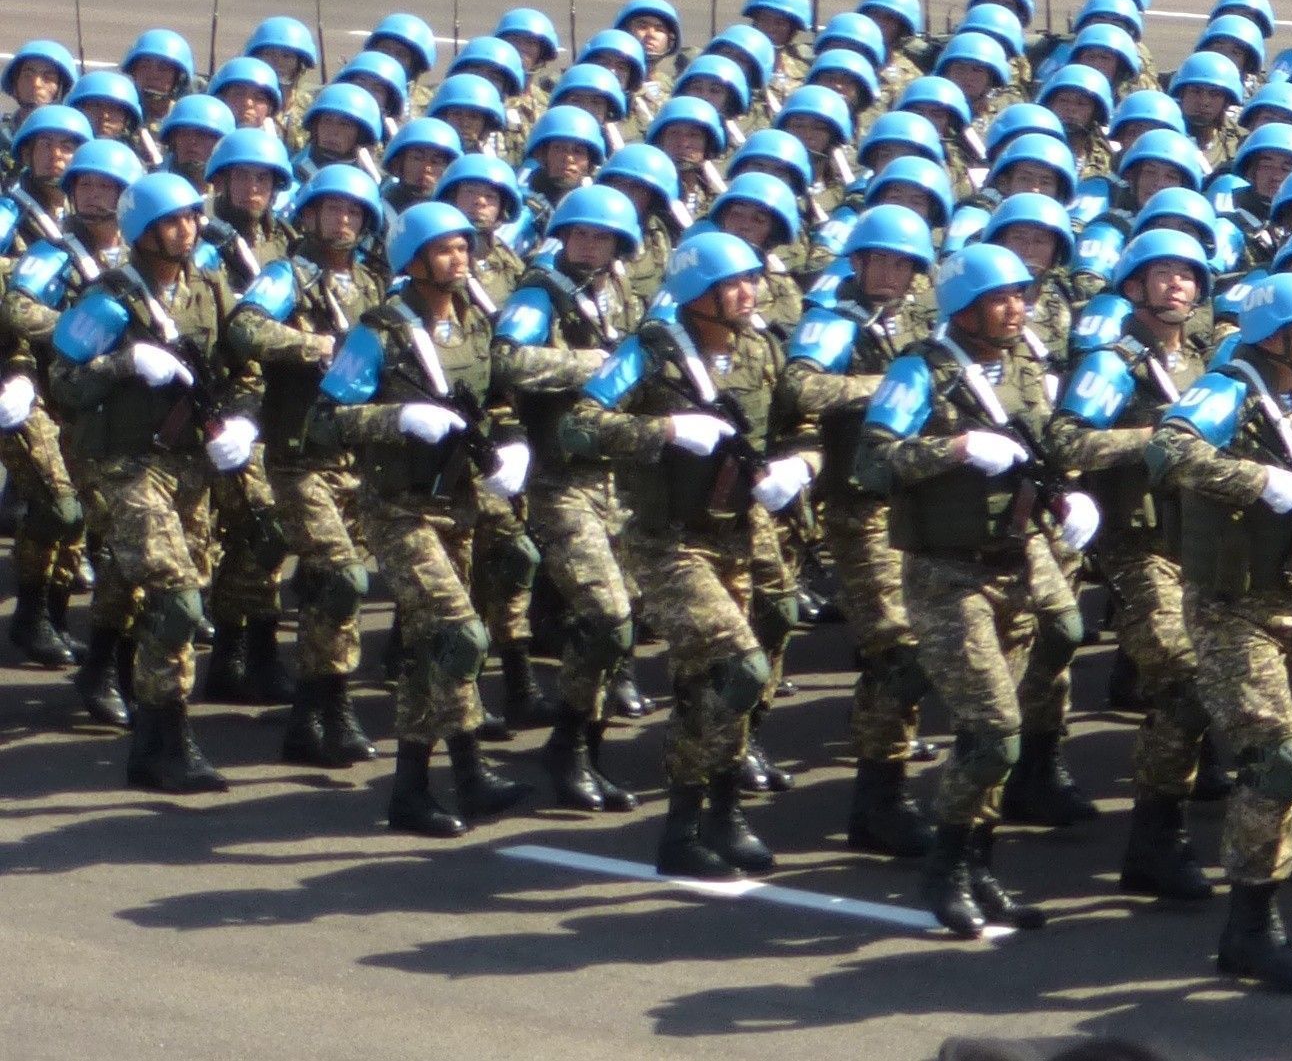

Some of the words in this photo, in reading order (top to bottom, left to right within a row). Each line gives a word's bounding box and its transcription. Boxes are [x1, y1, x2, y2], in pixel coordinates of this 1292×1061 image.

[1226, 284, 1252, 301] U
[1243, 286, 1275, 312] UN
[1076, 371, 1124, 417] UN
